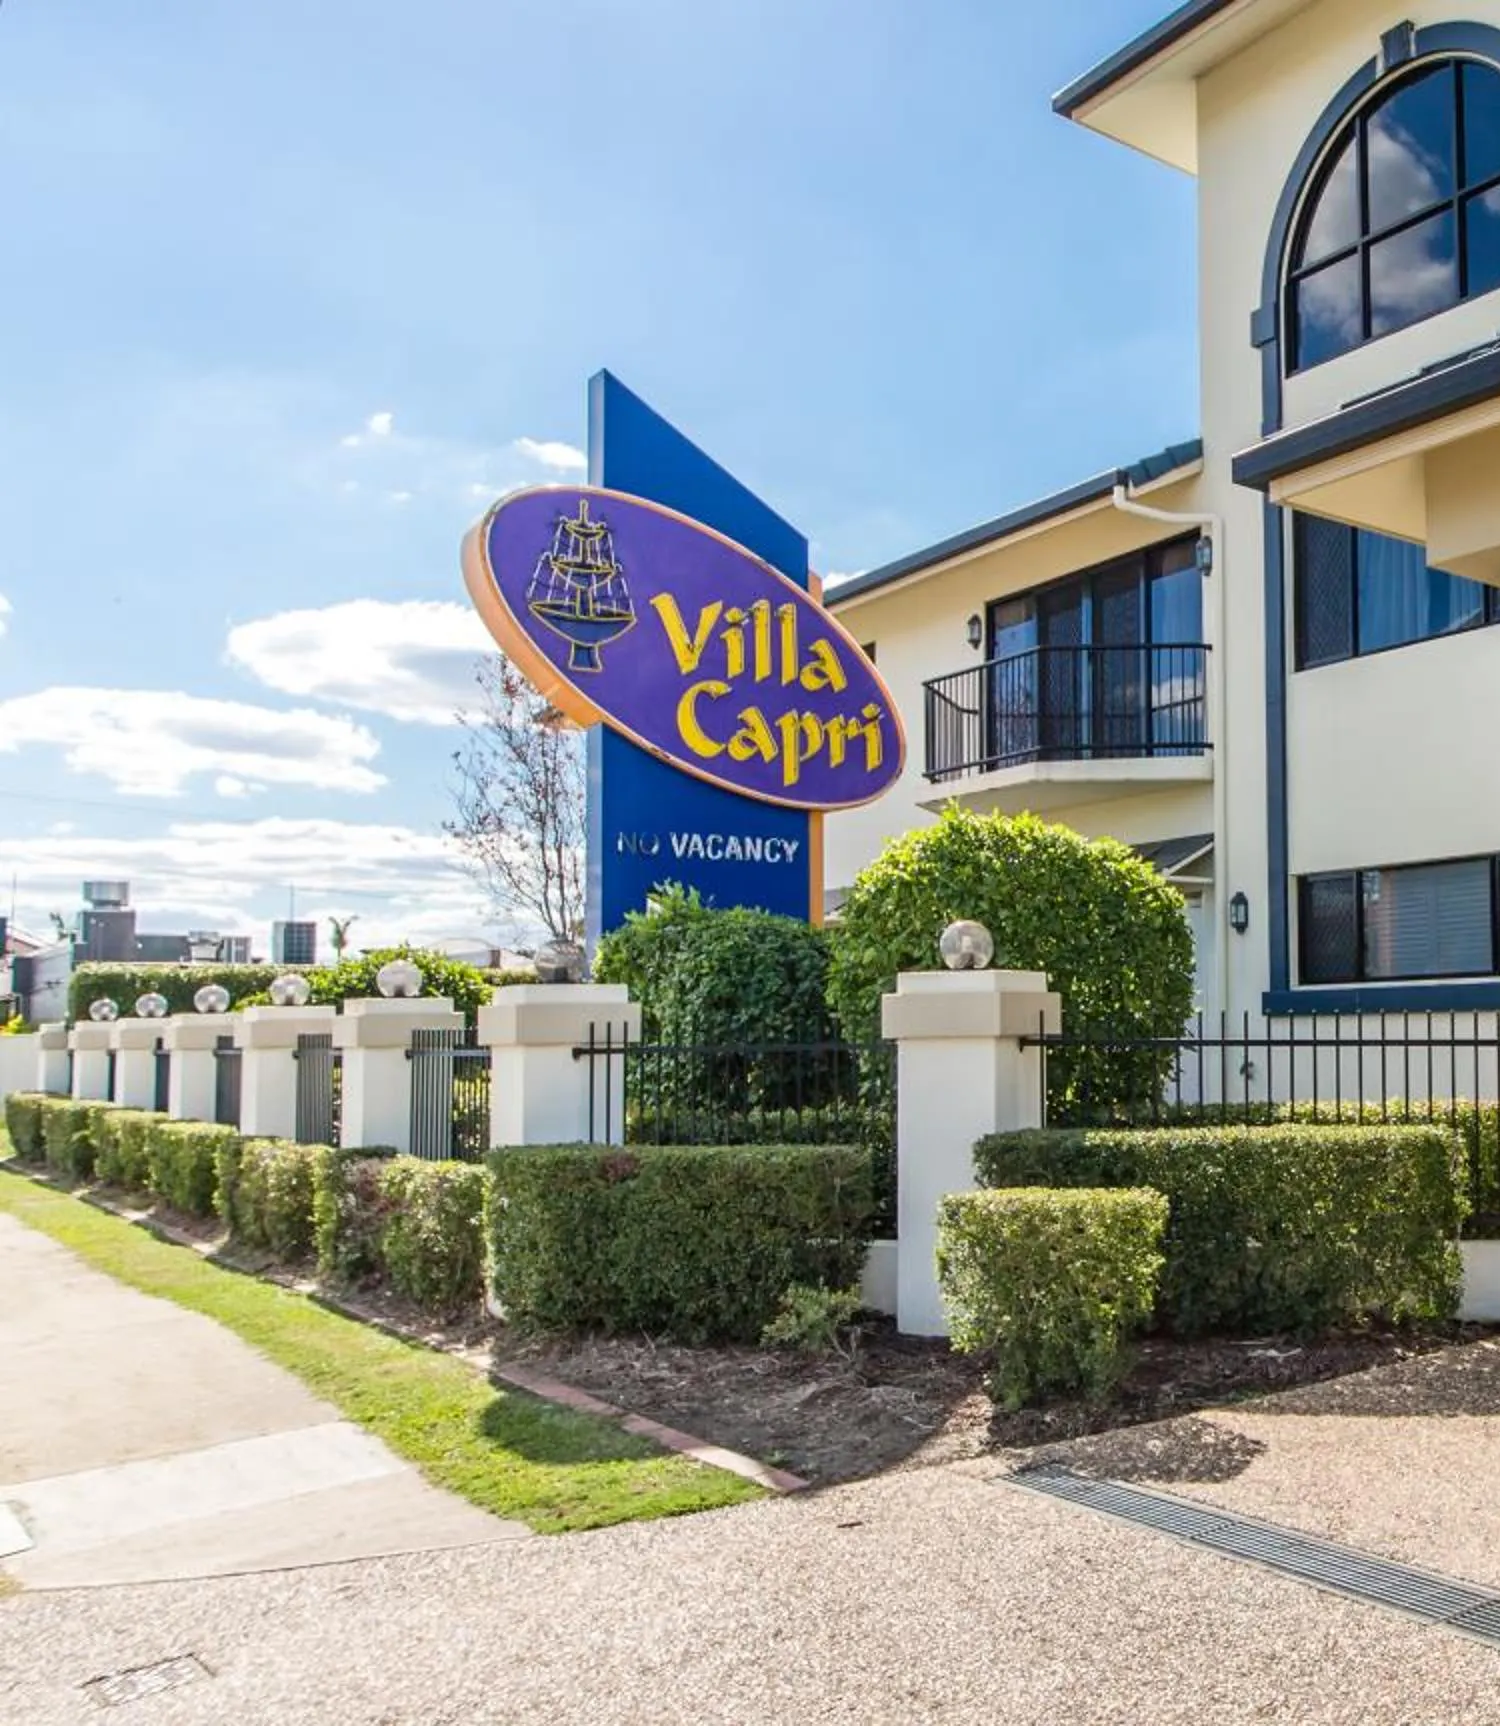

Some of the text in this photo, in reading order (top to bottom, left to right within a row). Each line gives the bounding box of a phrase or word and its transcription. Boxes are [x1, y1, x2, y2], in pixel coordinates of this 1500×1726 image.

[650, 592, 848, 693] Villa
[677, 680, 884, 787] Capri
[617, 831, 799, 863] NO VACANCY
